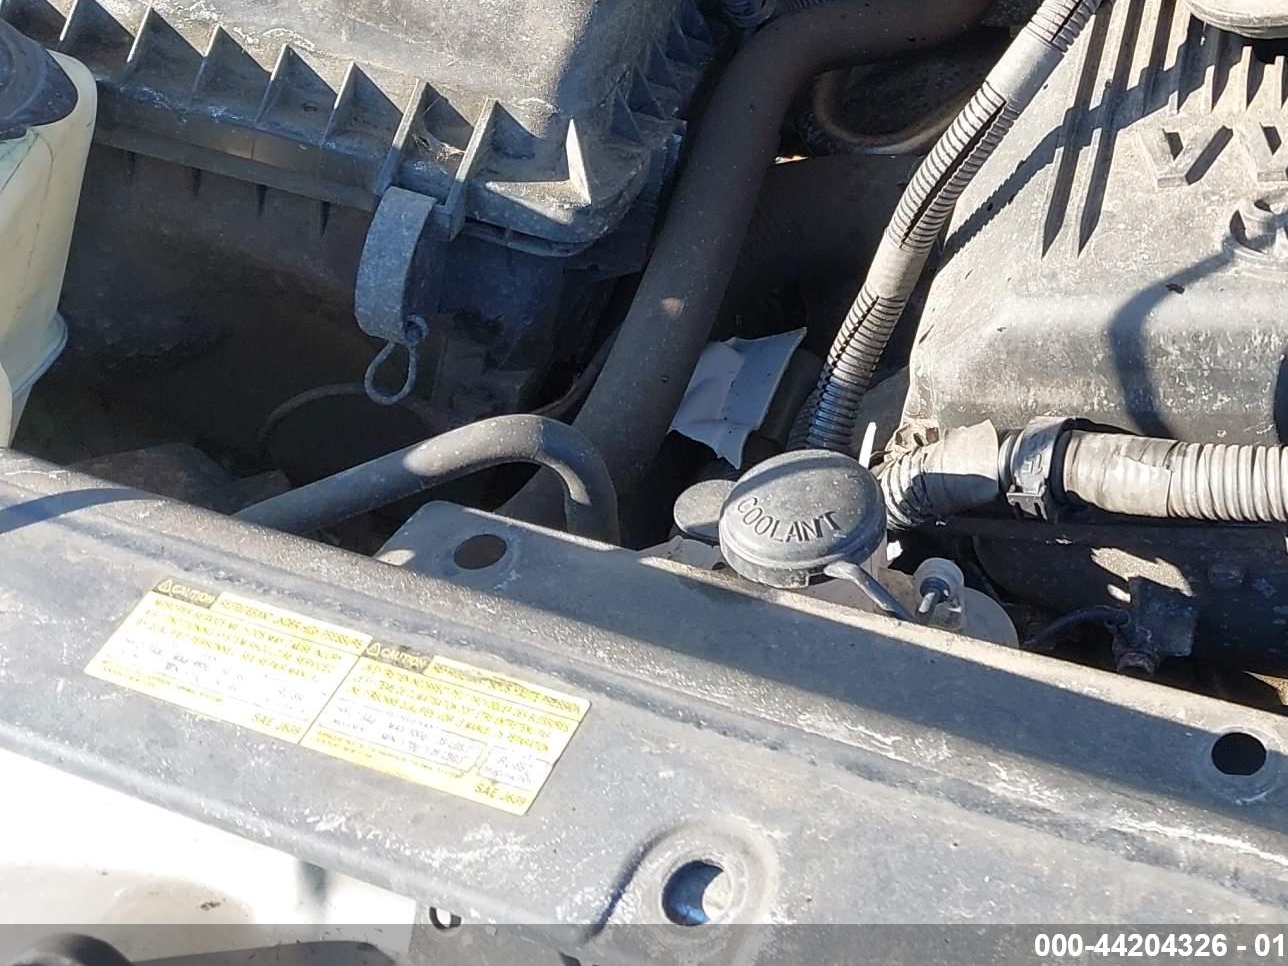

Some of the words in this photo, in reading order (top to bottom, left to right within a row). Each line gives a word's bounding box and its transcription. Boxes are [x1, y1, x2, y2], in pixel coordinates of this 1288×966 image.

[738, 496, 842, 543] COOLANT
[172, 584, 216, 606] CAUTION
[381, 649, 427, 669] CAUTION
[473, 782, 499, 798] SAE
